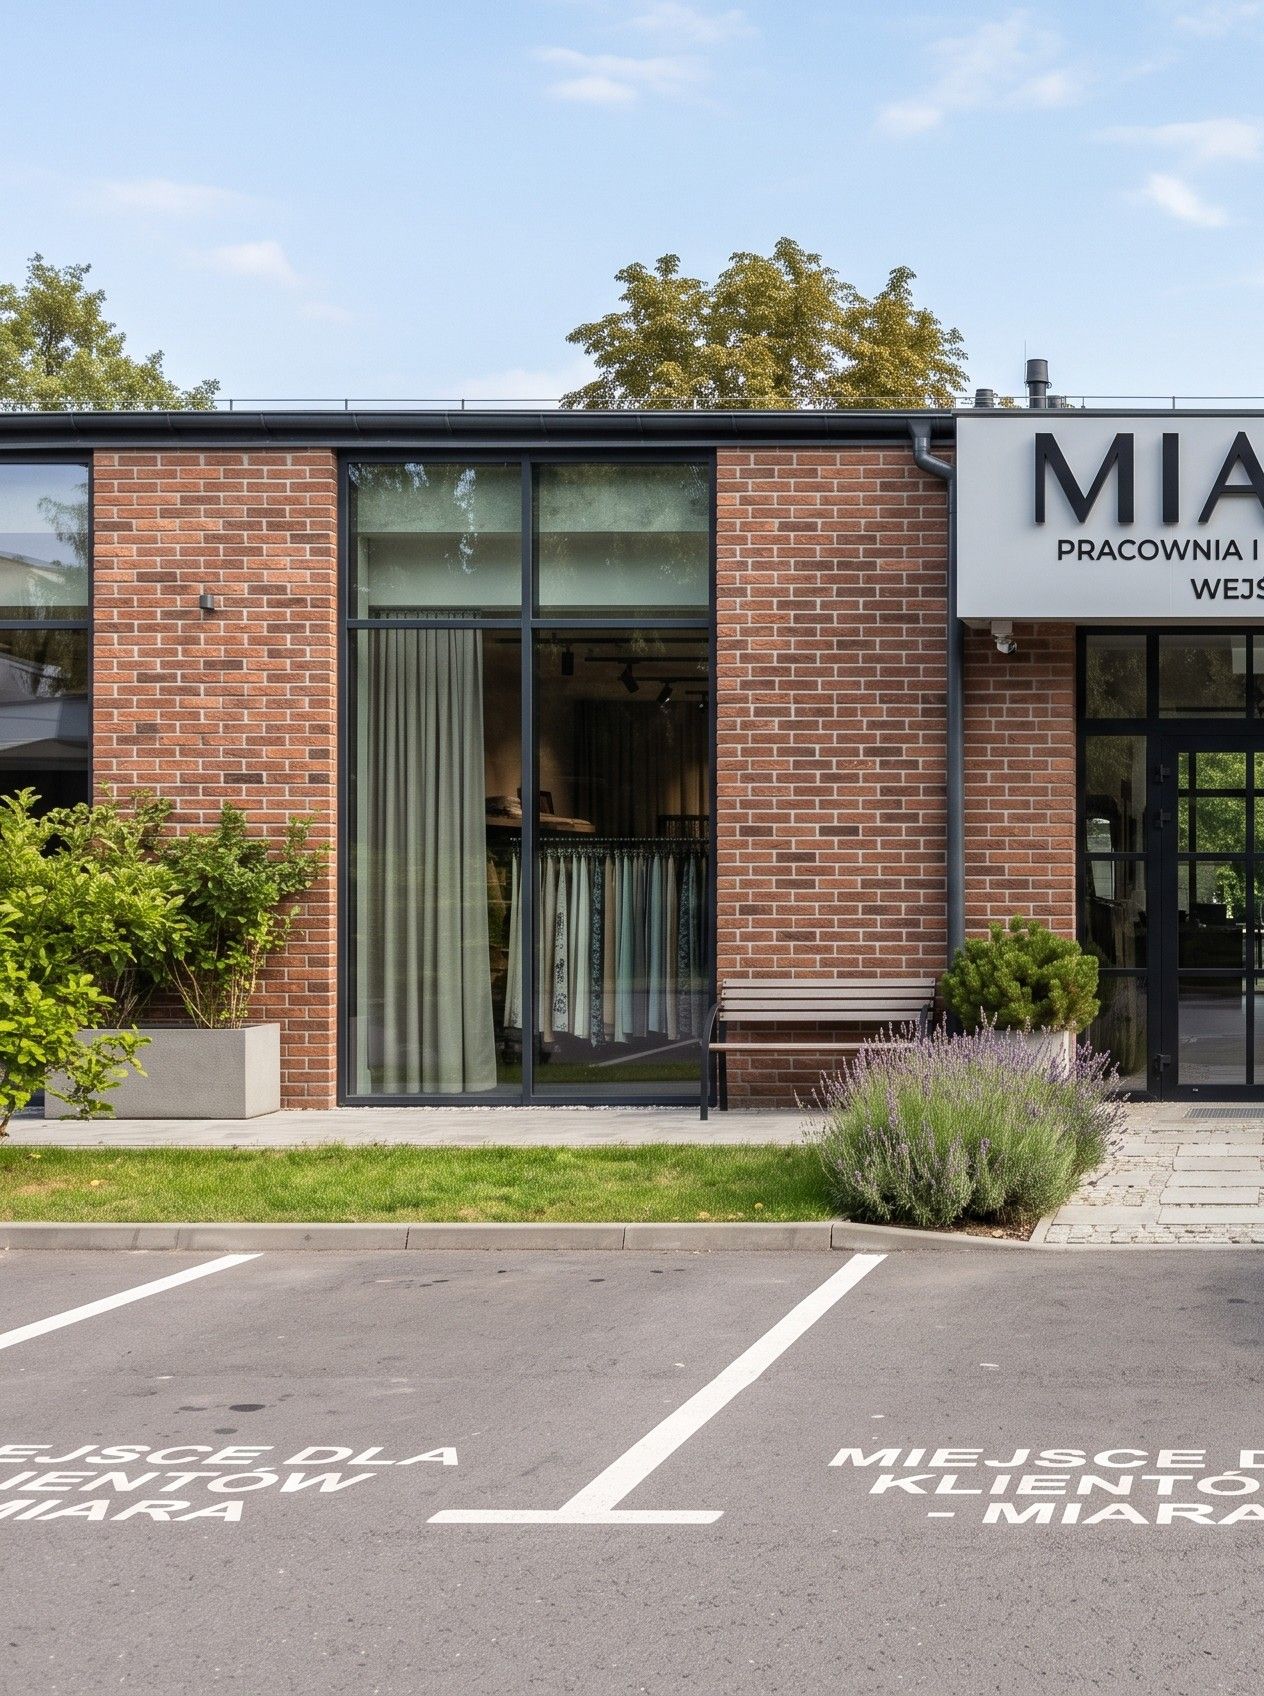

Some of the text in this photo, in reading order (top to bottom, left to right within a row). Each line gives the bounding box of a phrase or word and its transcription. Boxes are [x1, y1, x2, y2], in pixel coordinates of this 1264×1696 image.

[1057, 538, 1243, 561] PRACOWNIA
[1253, 539, 1258, 561] I
[283, 1446, 459, 1466] DLA
[828, 1447, 1207, 1469] MIEJSCE
